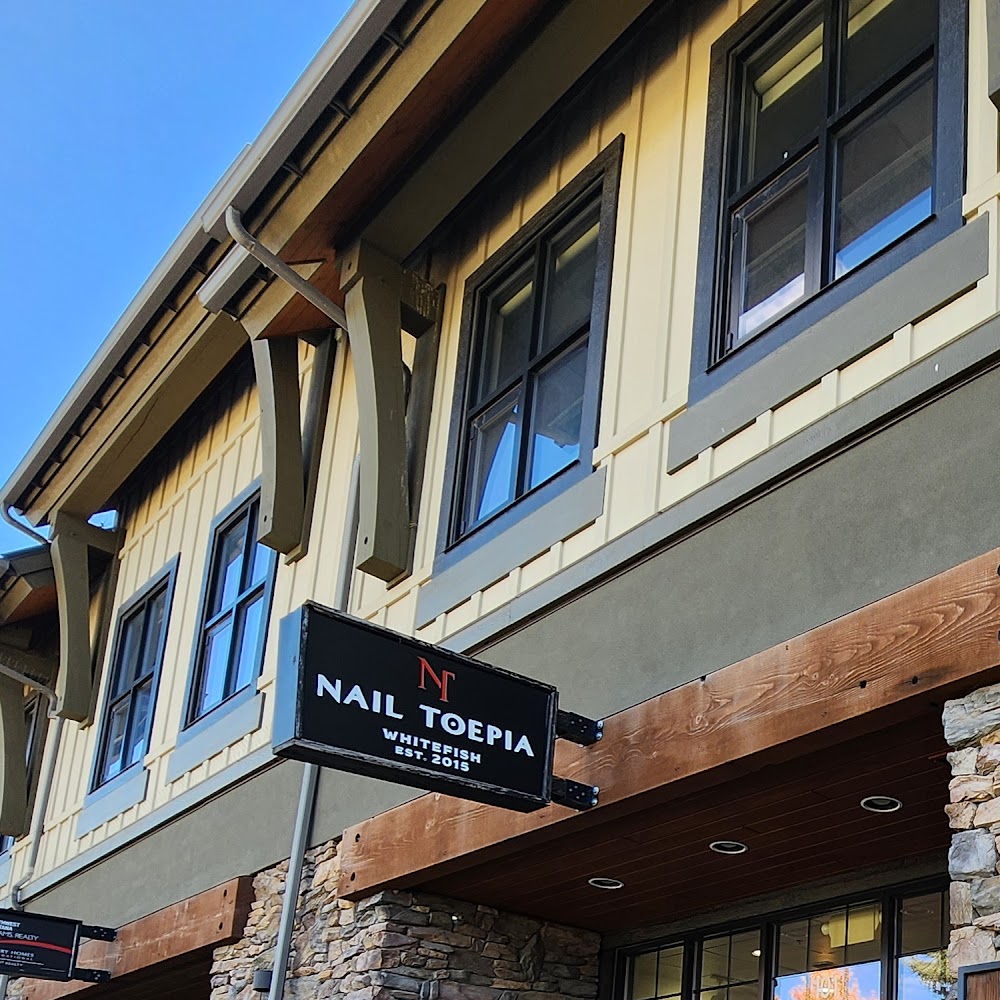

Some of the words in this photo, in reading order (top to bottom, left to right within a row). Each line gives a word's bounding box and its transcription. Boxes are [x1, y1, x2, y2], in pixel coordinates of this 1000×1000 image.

[317, 674, 404, 719] NAIL
[419, 704, 534, 757] TOEPIA
[382, 728, 481, 764] WHITEFISH
[395, 746, 427, 761] EST.
[432, 753, 470, 772] 2015
